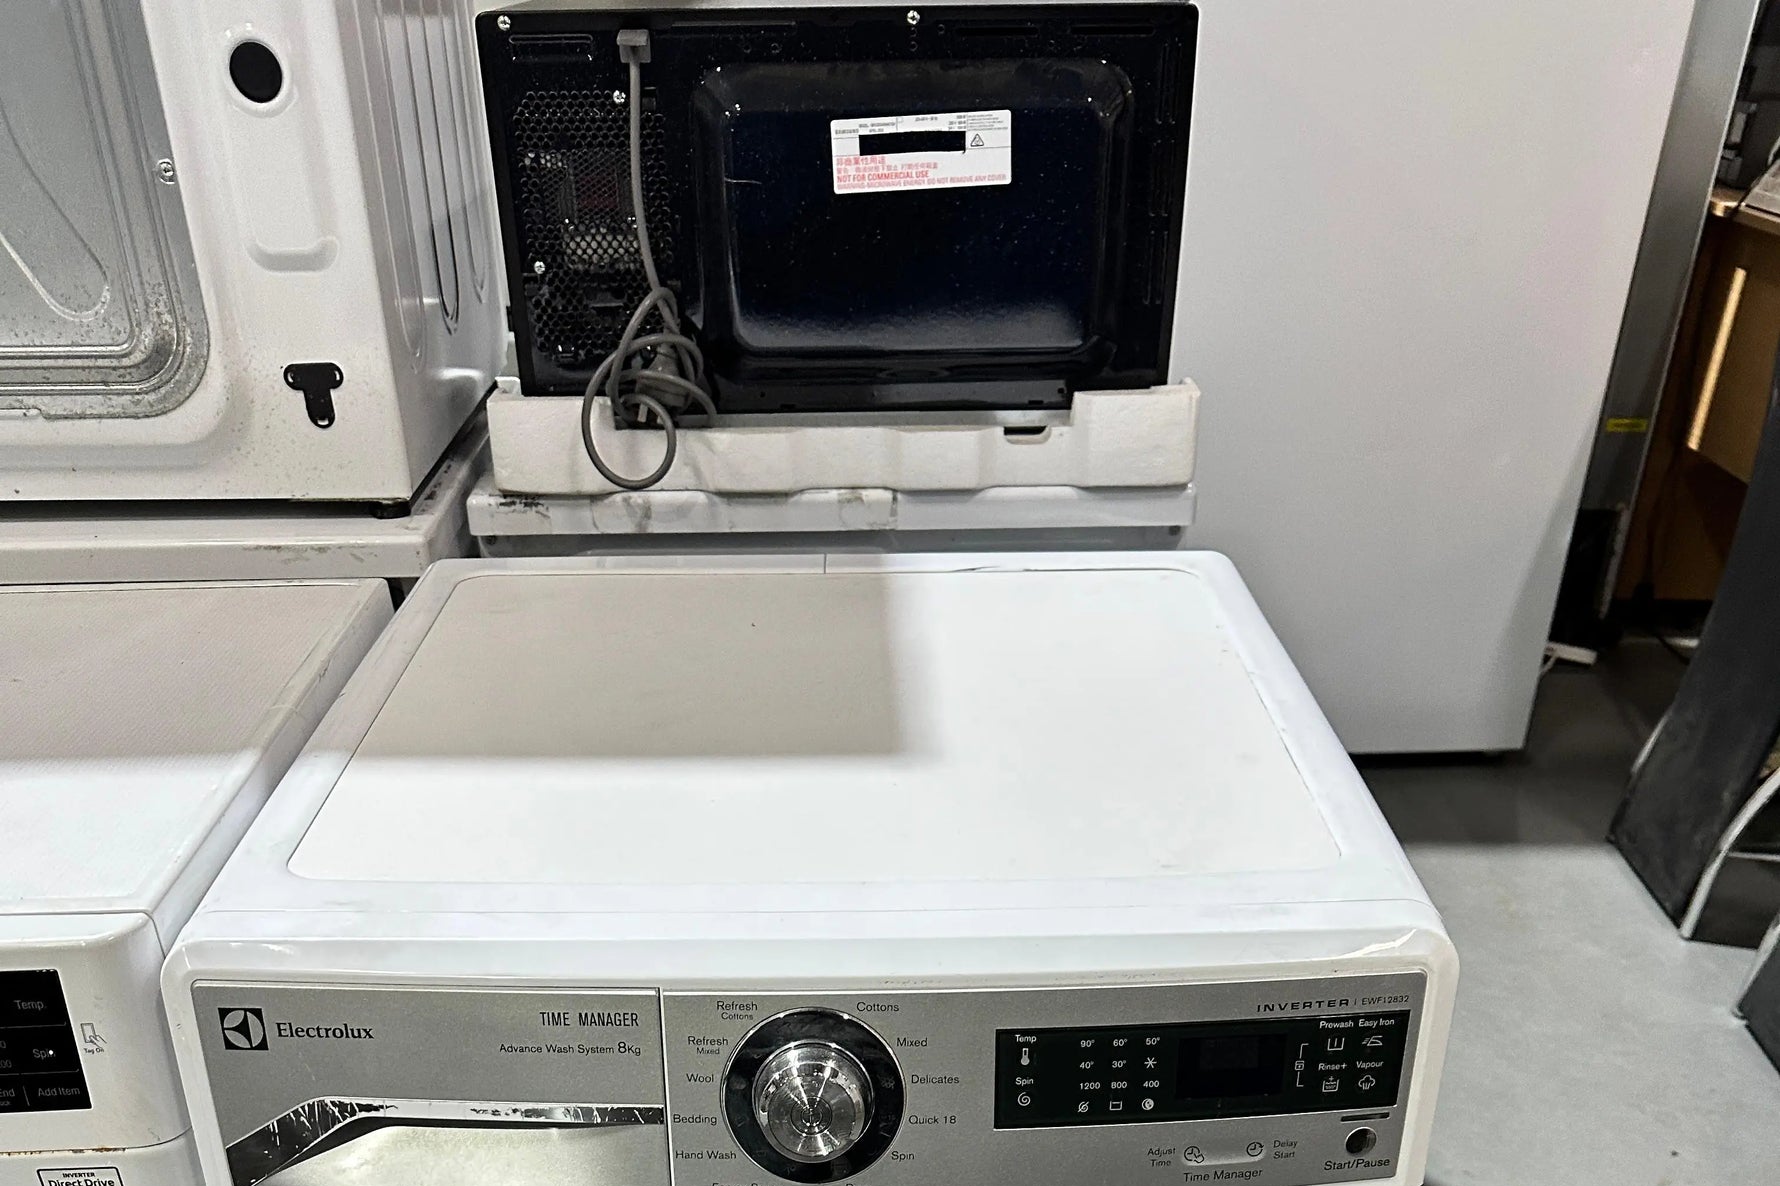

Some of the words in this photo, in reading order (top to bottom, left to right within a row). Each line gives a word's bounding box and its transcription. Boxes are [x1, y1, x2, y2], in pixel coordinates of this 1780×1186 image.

[837, 175, 852, 183] NOT
[853, 174, 865, 182] FOR
[868, 171, 914, 181] COMMERCIAL
[916, 170, 929, 179] USE
[717, 1001, 758, 1012] Refresh
[856, 1002, 900, 1012] Cottons
[1257, 998, 1350, 1013] INVERTER
[1361, 995, 1410, 1006] EWF12832
[540, 1012, 570, 1026] TIME
[578, 1012, 639, 1027] MANAGER
[721, 1012, 754, 1020] Cottons
[1319, 1020, 1354, 1029] Prewash
[1358, 1019, 1378, 1029] Easy
[1379, 1018, 1395, 1026] Iron
[276, 1022, 375, 1040] Electrolux
[688, 1036, 728, 1047] Refresh
[896, 1037, 928, 1048] Mixed
[1015, 1034, 1037, 1043] Temp
[500, 1043, 542, 1053] Advance
[545, 1044, 574, 1053] Wash
[577, 1044, 614, 1056] System
[617, 1041, 641, 1056] 8Kg
[696, 1047, 720, 1055] Mixed
[1356, 1060, 1384, 1069] Vapour
[686, 1073, 714, 1083] Wool
[911, 1074, 960, 1085] Delicates
[1015, 1077, 1034, 1087] Spin
[1080, 1082, 1101, 1090] 1200
[1111, 1081, 1128, 1089] 800
[1143, 1080, 1160, 1088] 400
[38, 1087, 58, 1097] Add
[59, 1086, 80, 1096] Item
[673, 1114, 718, 1126] Bedding
[909, 1114, 939, 1125] Quick
[943, 1115, 957, 1125] 18
[1273, 1140, 1298, 1150] Delay
[675, 1150, 704, 1160] Hand
[707, 1150, 737, 1160] Wash
[891, 1150, 915, 1163] Spin
[1147, 1147, 1176, 1158] Adjust
[1273, 1151, 1295, 1160] Start
[1150, 1159, 1171, 1167] Time
[1324, 1158, 1391, 1171] Start/Pause
[1183, 1172, 1210, 1182] Time
[1213, 1169, 1263, 1182] Manager
[84, 1179, 115, 1186] Drive
